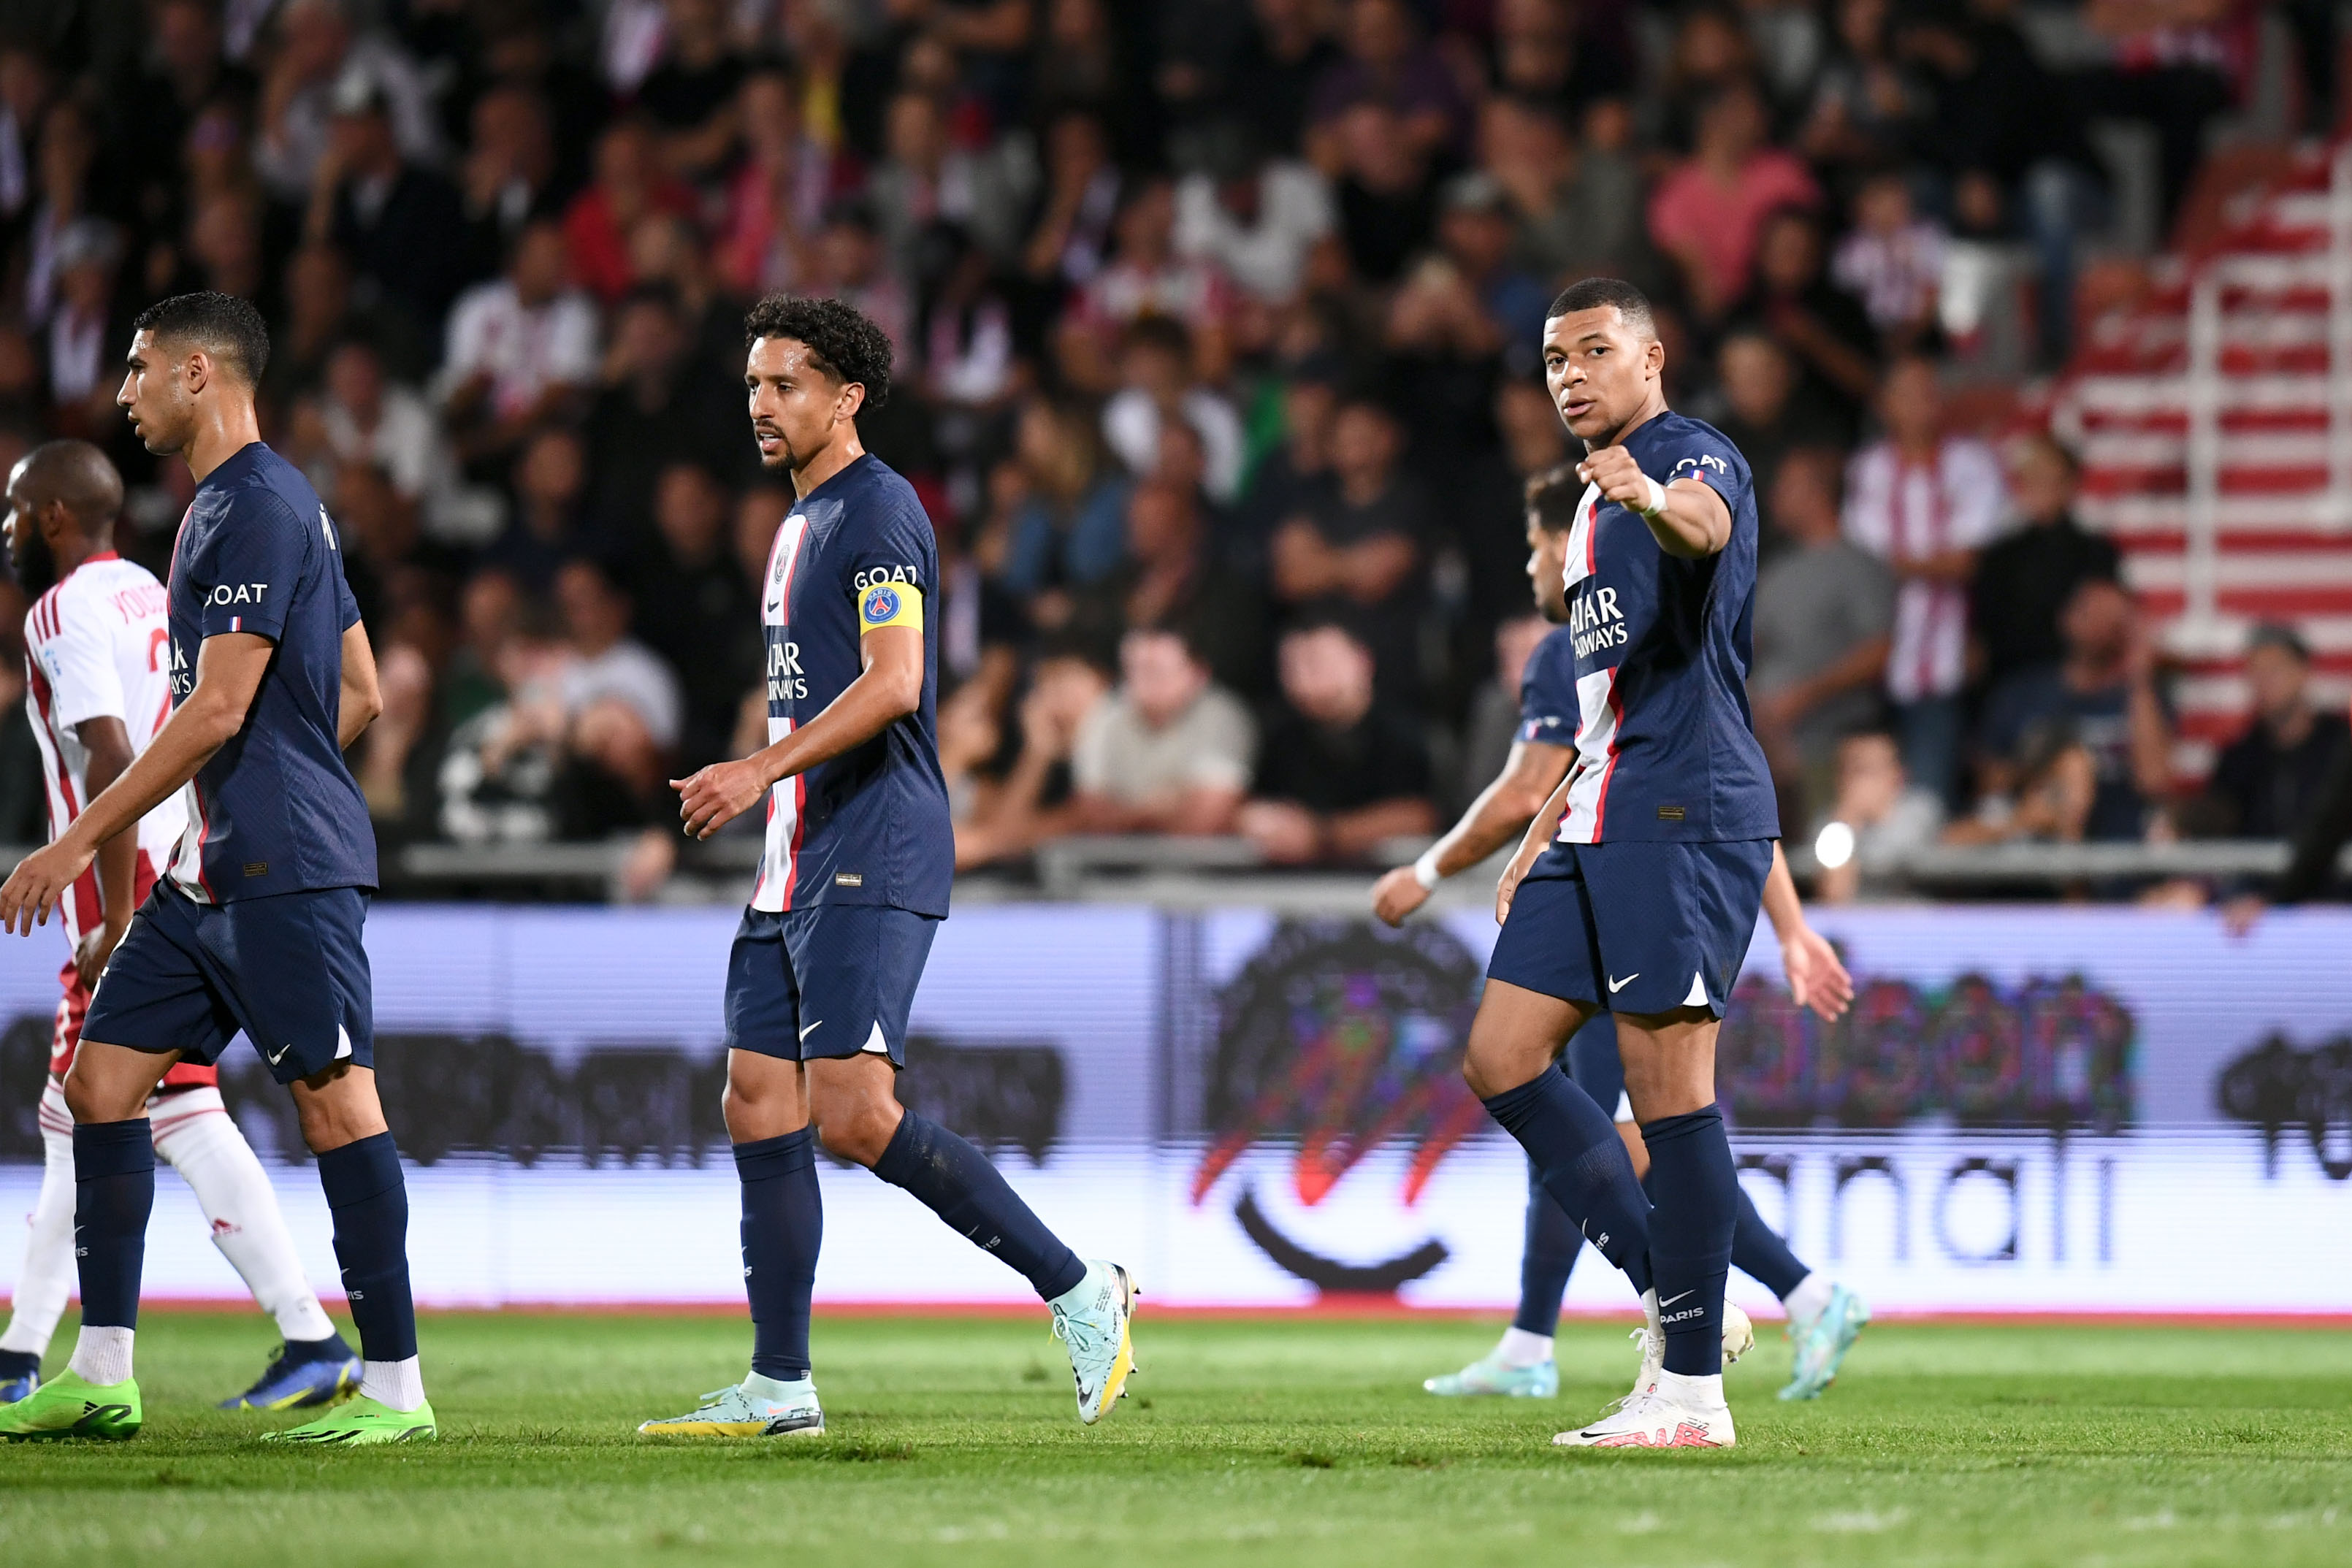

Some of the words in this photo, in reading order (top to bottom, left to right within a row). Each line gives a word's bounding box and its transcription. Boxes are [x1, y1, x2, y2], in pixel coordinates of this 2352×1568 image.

[1669, 454, 1727, 478] OAT
[868, 589, 893, 602] PARIS
[1660, 1307, 1704, 1324] PARIS
